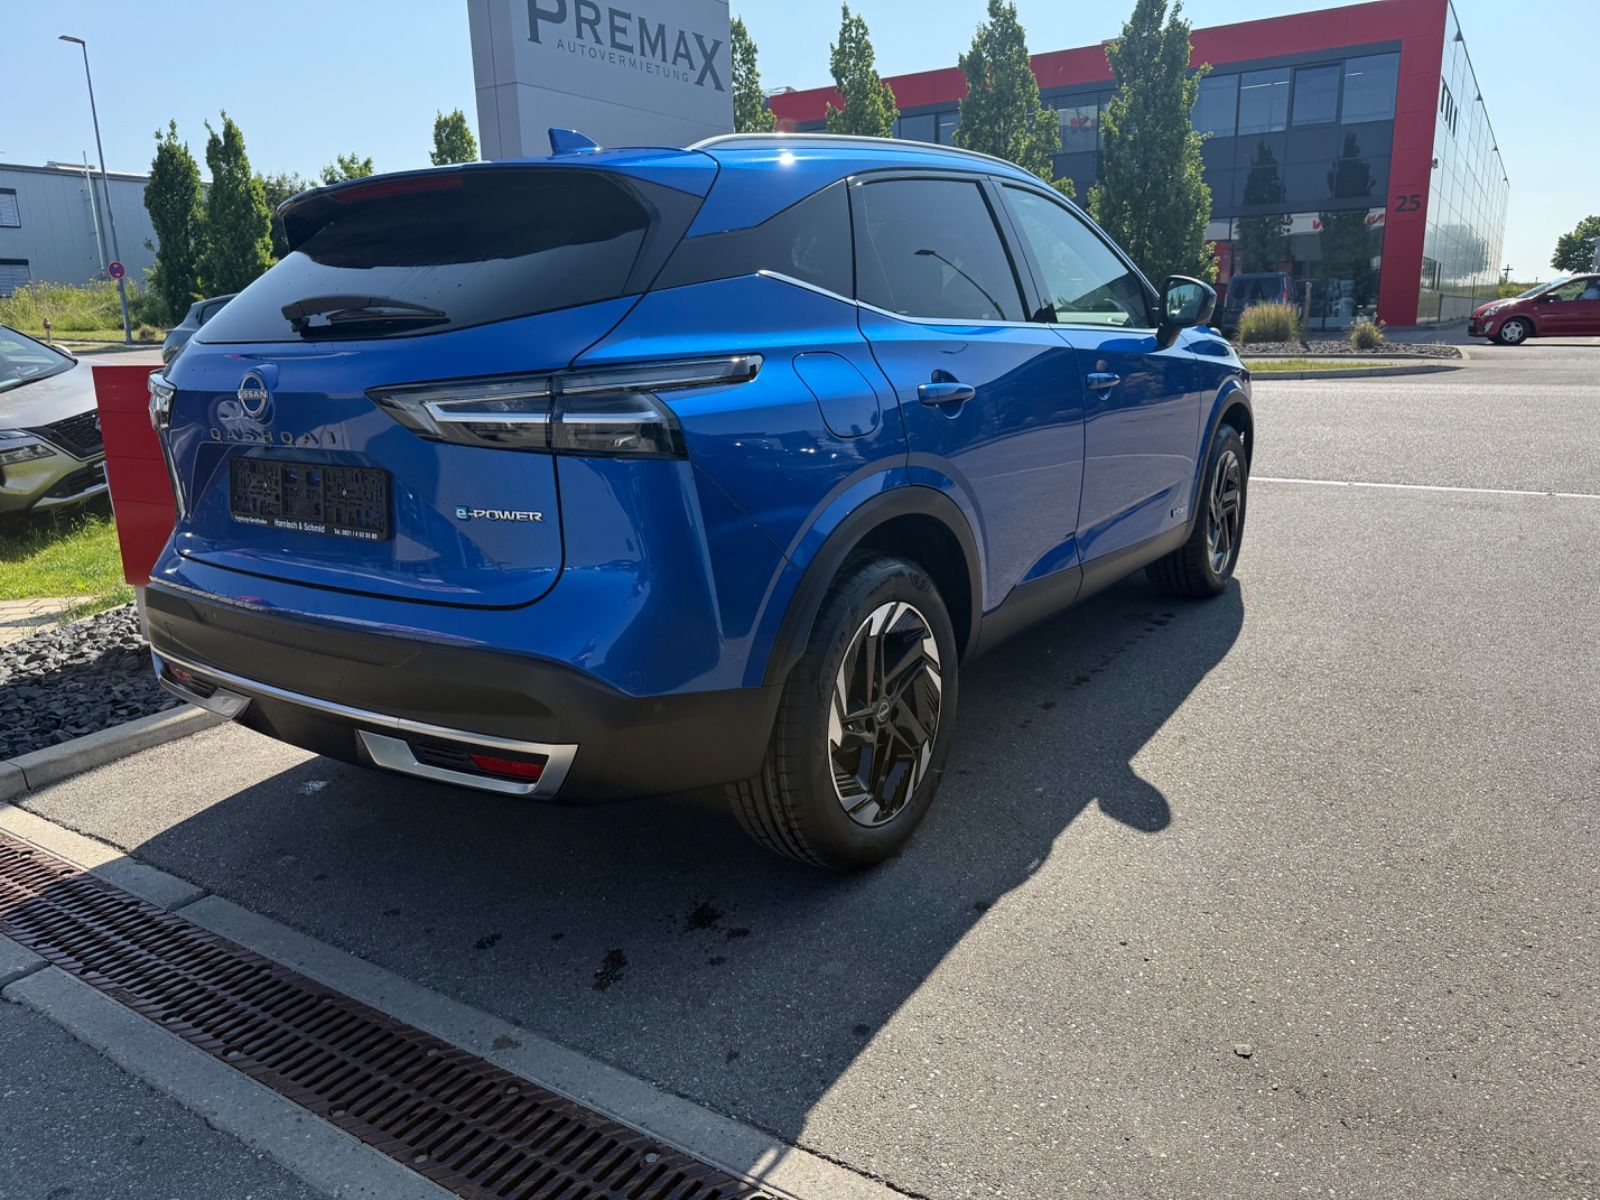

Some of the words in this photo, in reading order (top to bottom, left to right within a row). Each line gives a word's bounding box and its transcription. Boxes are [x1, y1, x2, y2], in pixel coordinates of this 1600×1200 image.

[528, 0, 725, 92] PREMAX
[557, 38, 689, 83] AUTOVERMIETUNG
[1395, 195, 1421, 213] 25
[238, 390, 268, 400] NISSAN
[210, 428, 337, 446] QASHQAI
[455, 507, 544, 522] e-POWER
